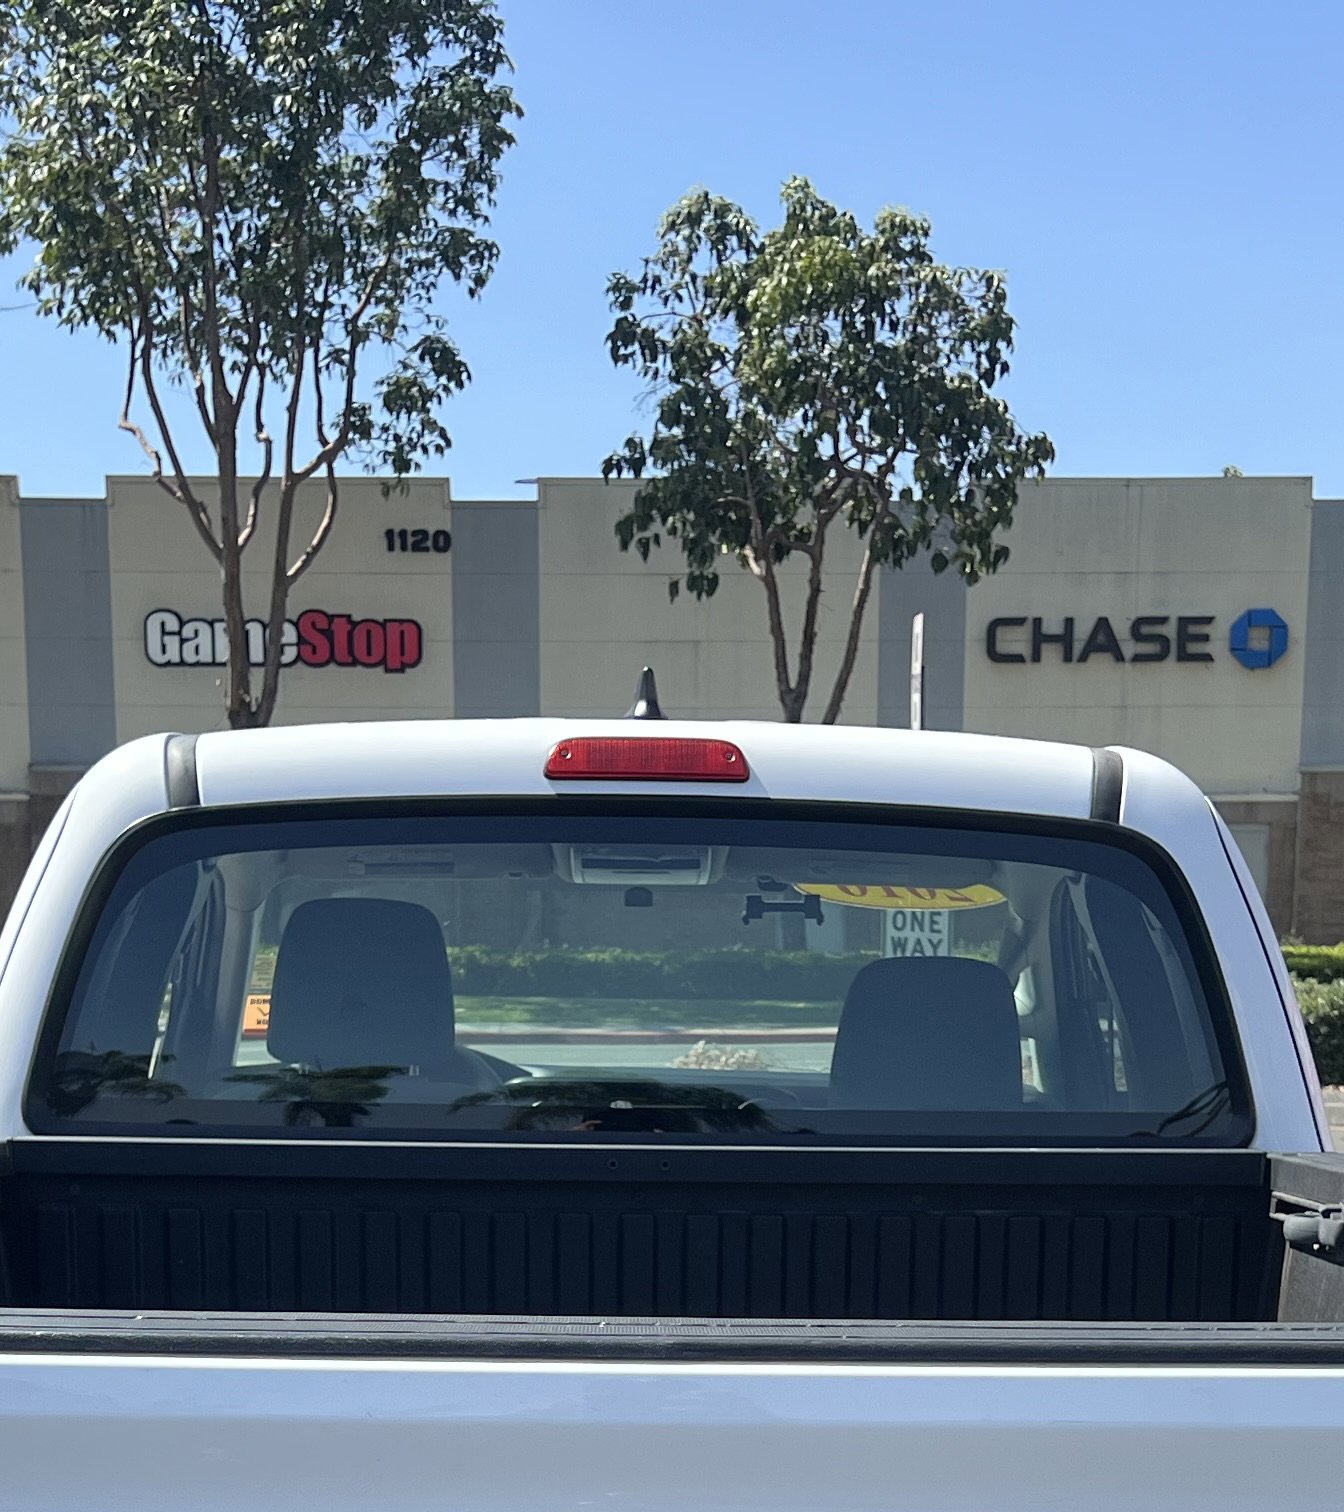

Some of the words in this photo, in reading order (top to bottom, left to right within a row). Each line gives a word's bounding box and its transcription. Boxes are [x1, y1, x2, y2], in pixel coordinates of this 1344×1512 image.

[384, 528, 452, 553] 1120
[986, 616, 1216, 664] CHASE
[892, 909, 943, 934] ONE
[890, 935, 945, 957] WAY
